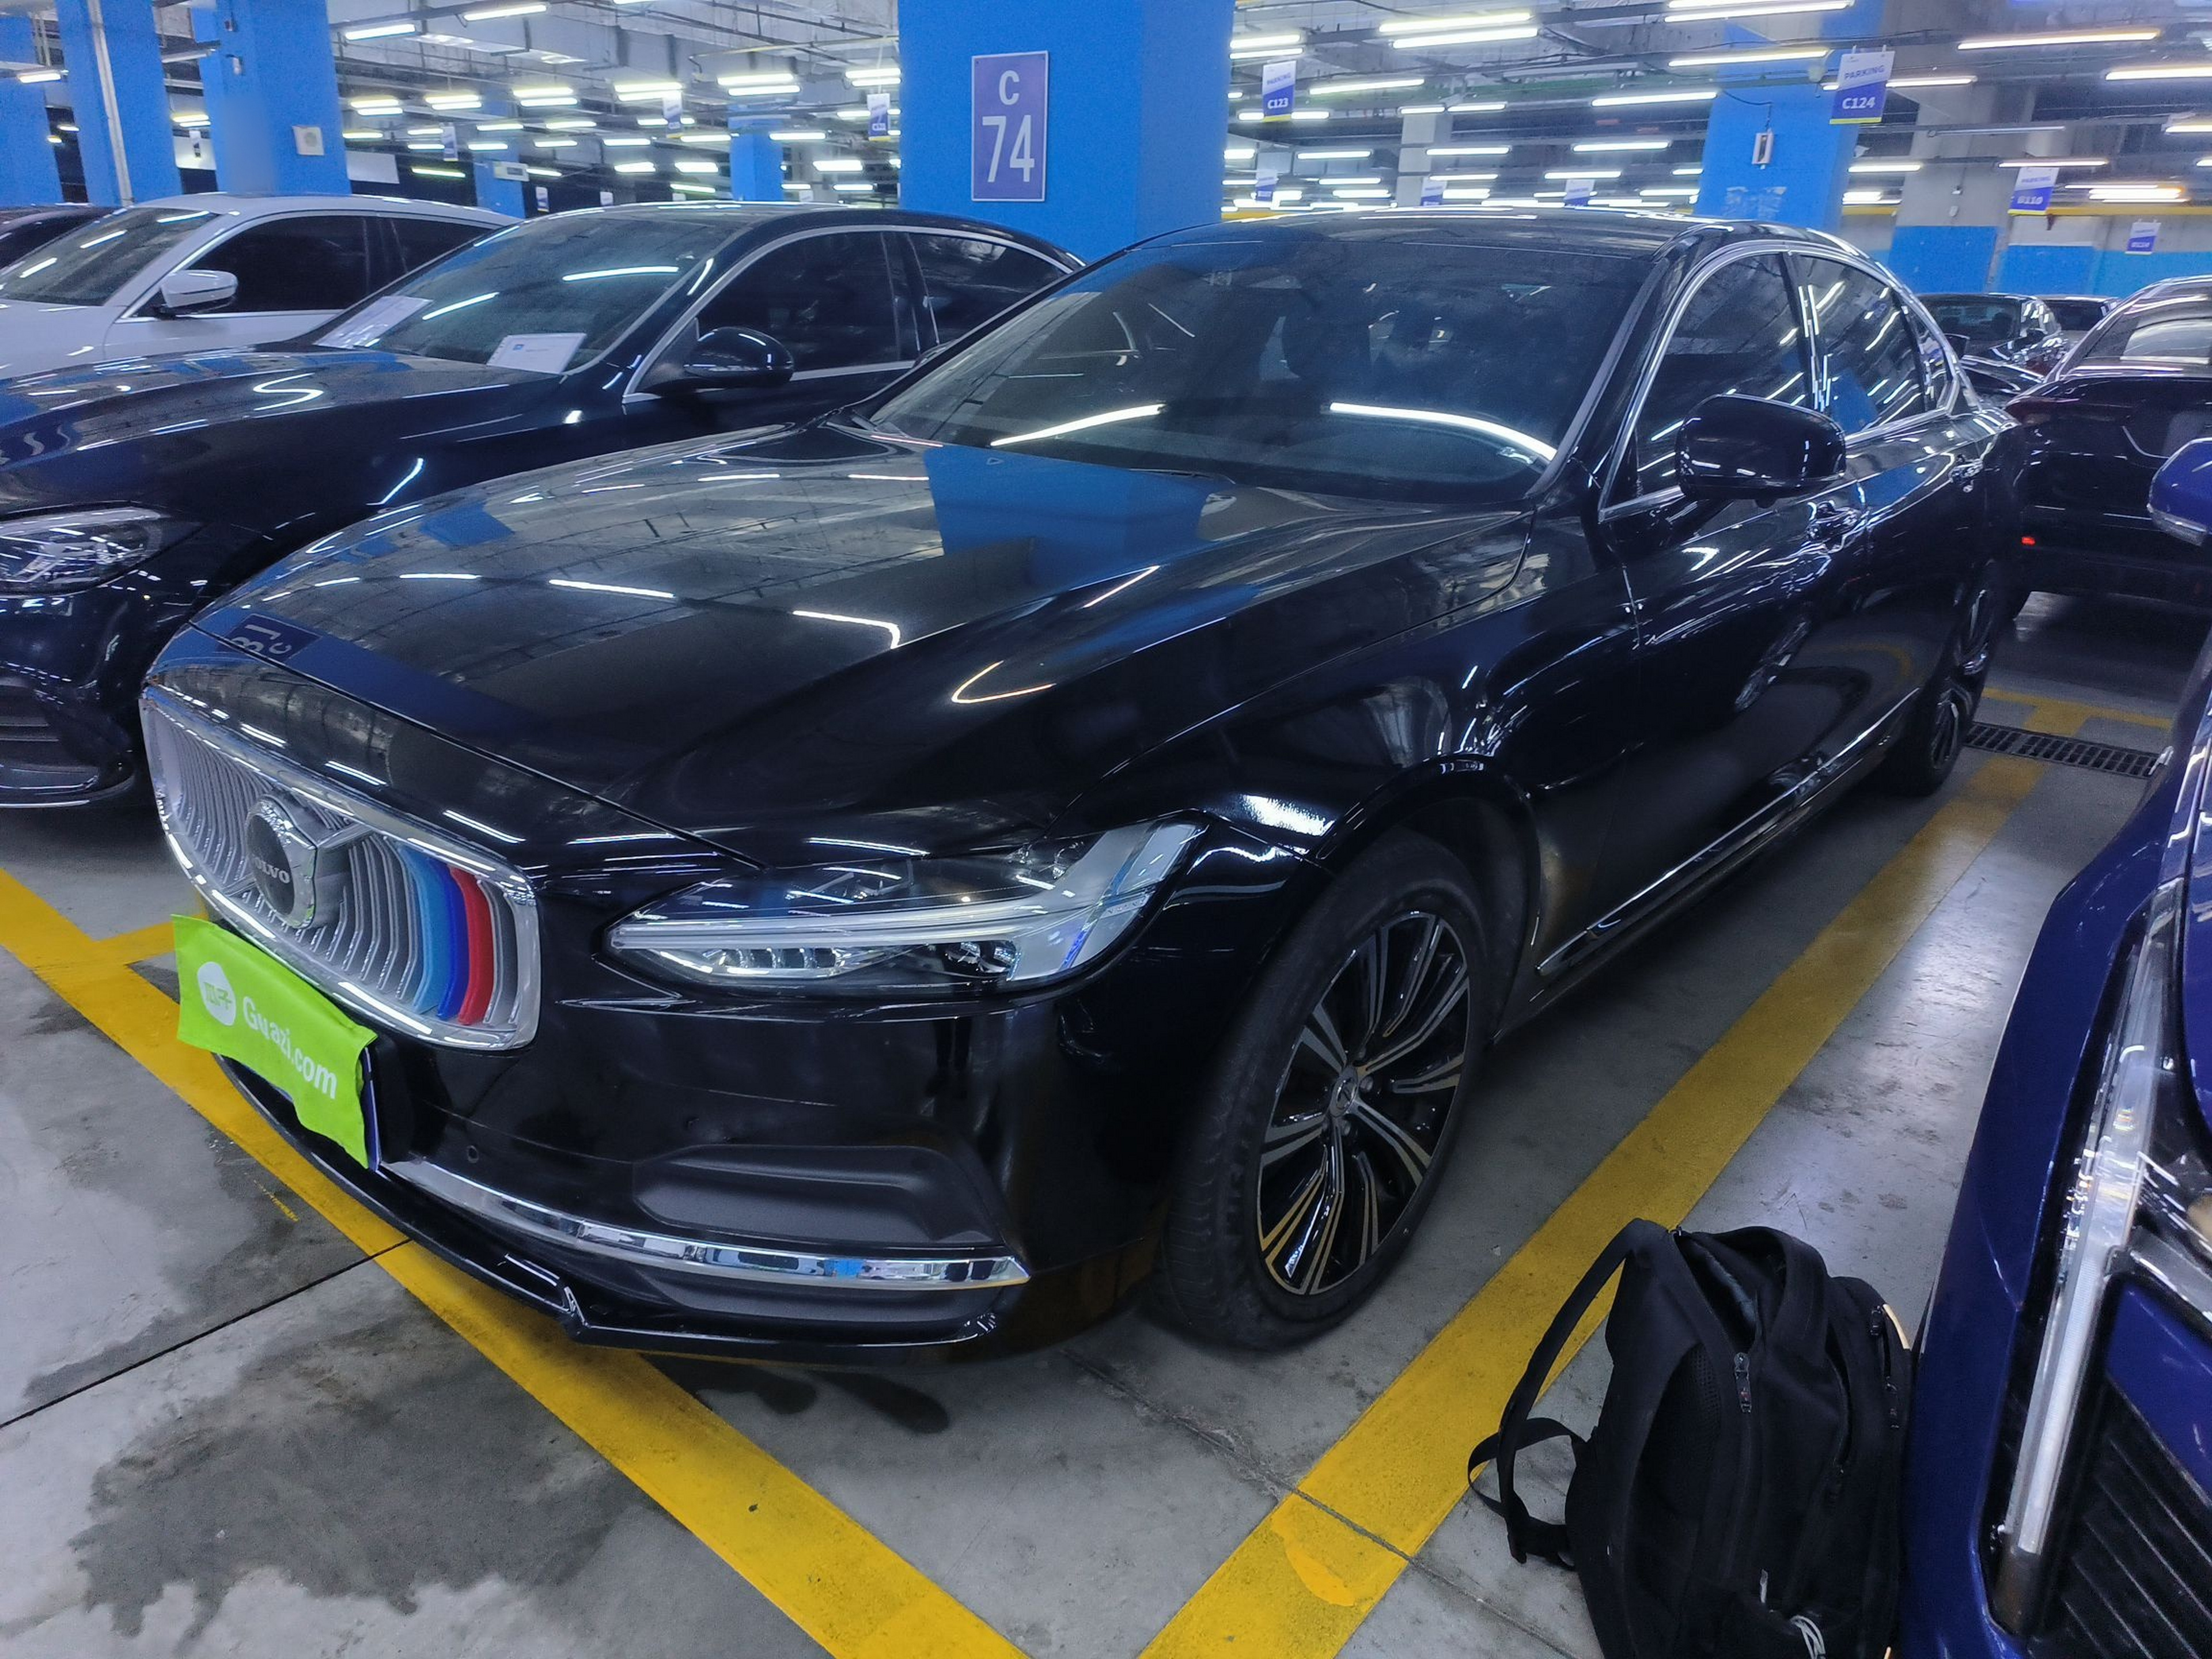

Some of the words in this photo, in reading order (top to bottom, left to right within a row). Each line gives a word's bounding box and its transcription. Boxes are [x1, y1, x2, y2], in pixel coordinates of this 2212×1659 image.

[1844, 65, 1885, 79] PARKING
[999, 70, 1020, 105] C
[1267, 97, 1289, 109] C123
[1842, 97, 1876, 109] C124
[982, 115, 1035, 183] 74
[243, 996, 338, 1099] Guazi.com
